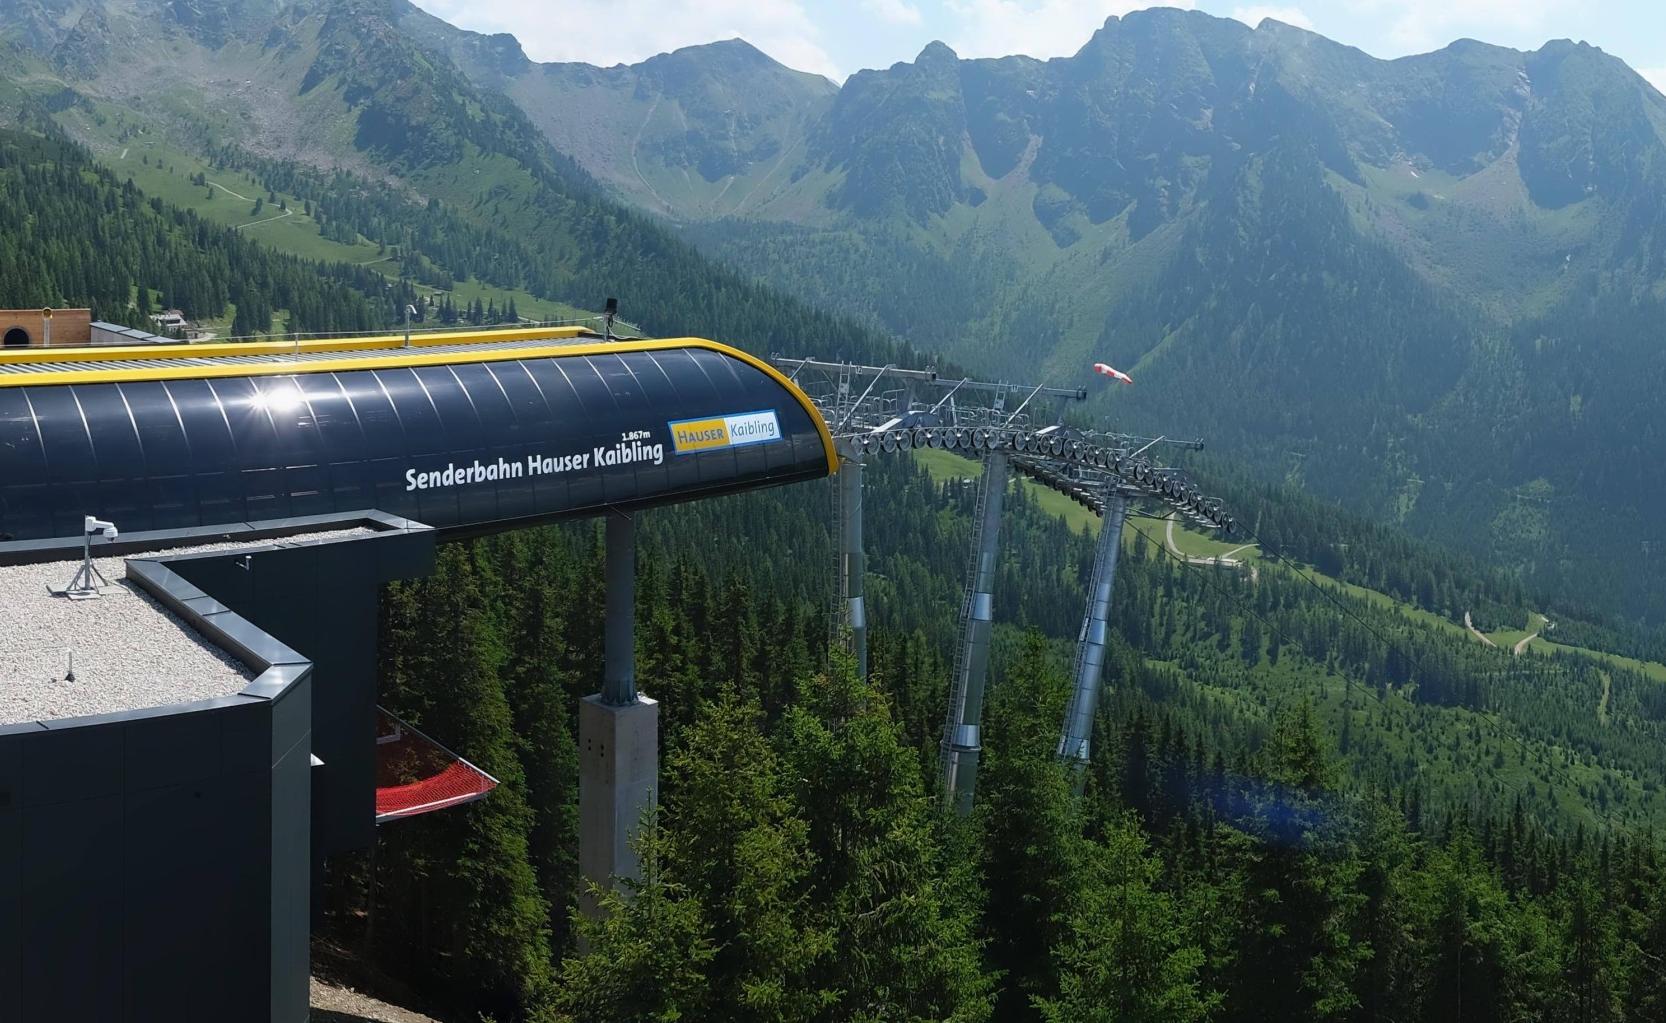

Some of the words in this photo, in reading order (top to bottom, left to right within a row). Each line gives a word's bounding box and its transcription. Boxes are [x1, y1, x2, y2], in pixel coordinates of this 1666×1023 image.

[622, 430, 651, 442] 1.867m
[677, 428, 725, 445] HAUSER
[730, 420, 775, 437] Kaibling
[406, 457, 523, 492] Senderbahn
[527, 452, 590, 477] Hauser
[593, 441, 664, 467] Kaibling
